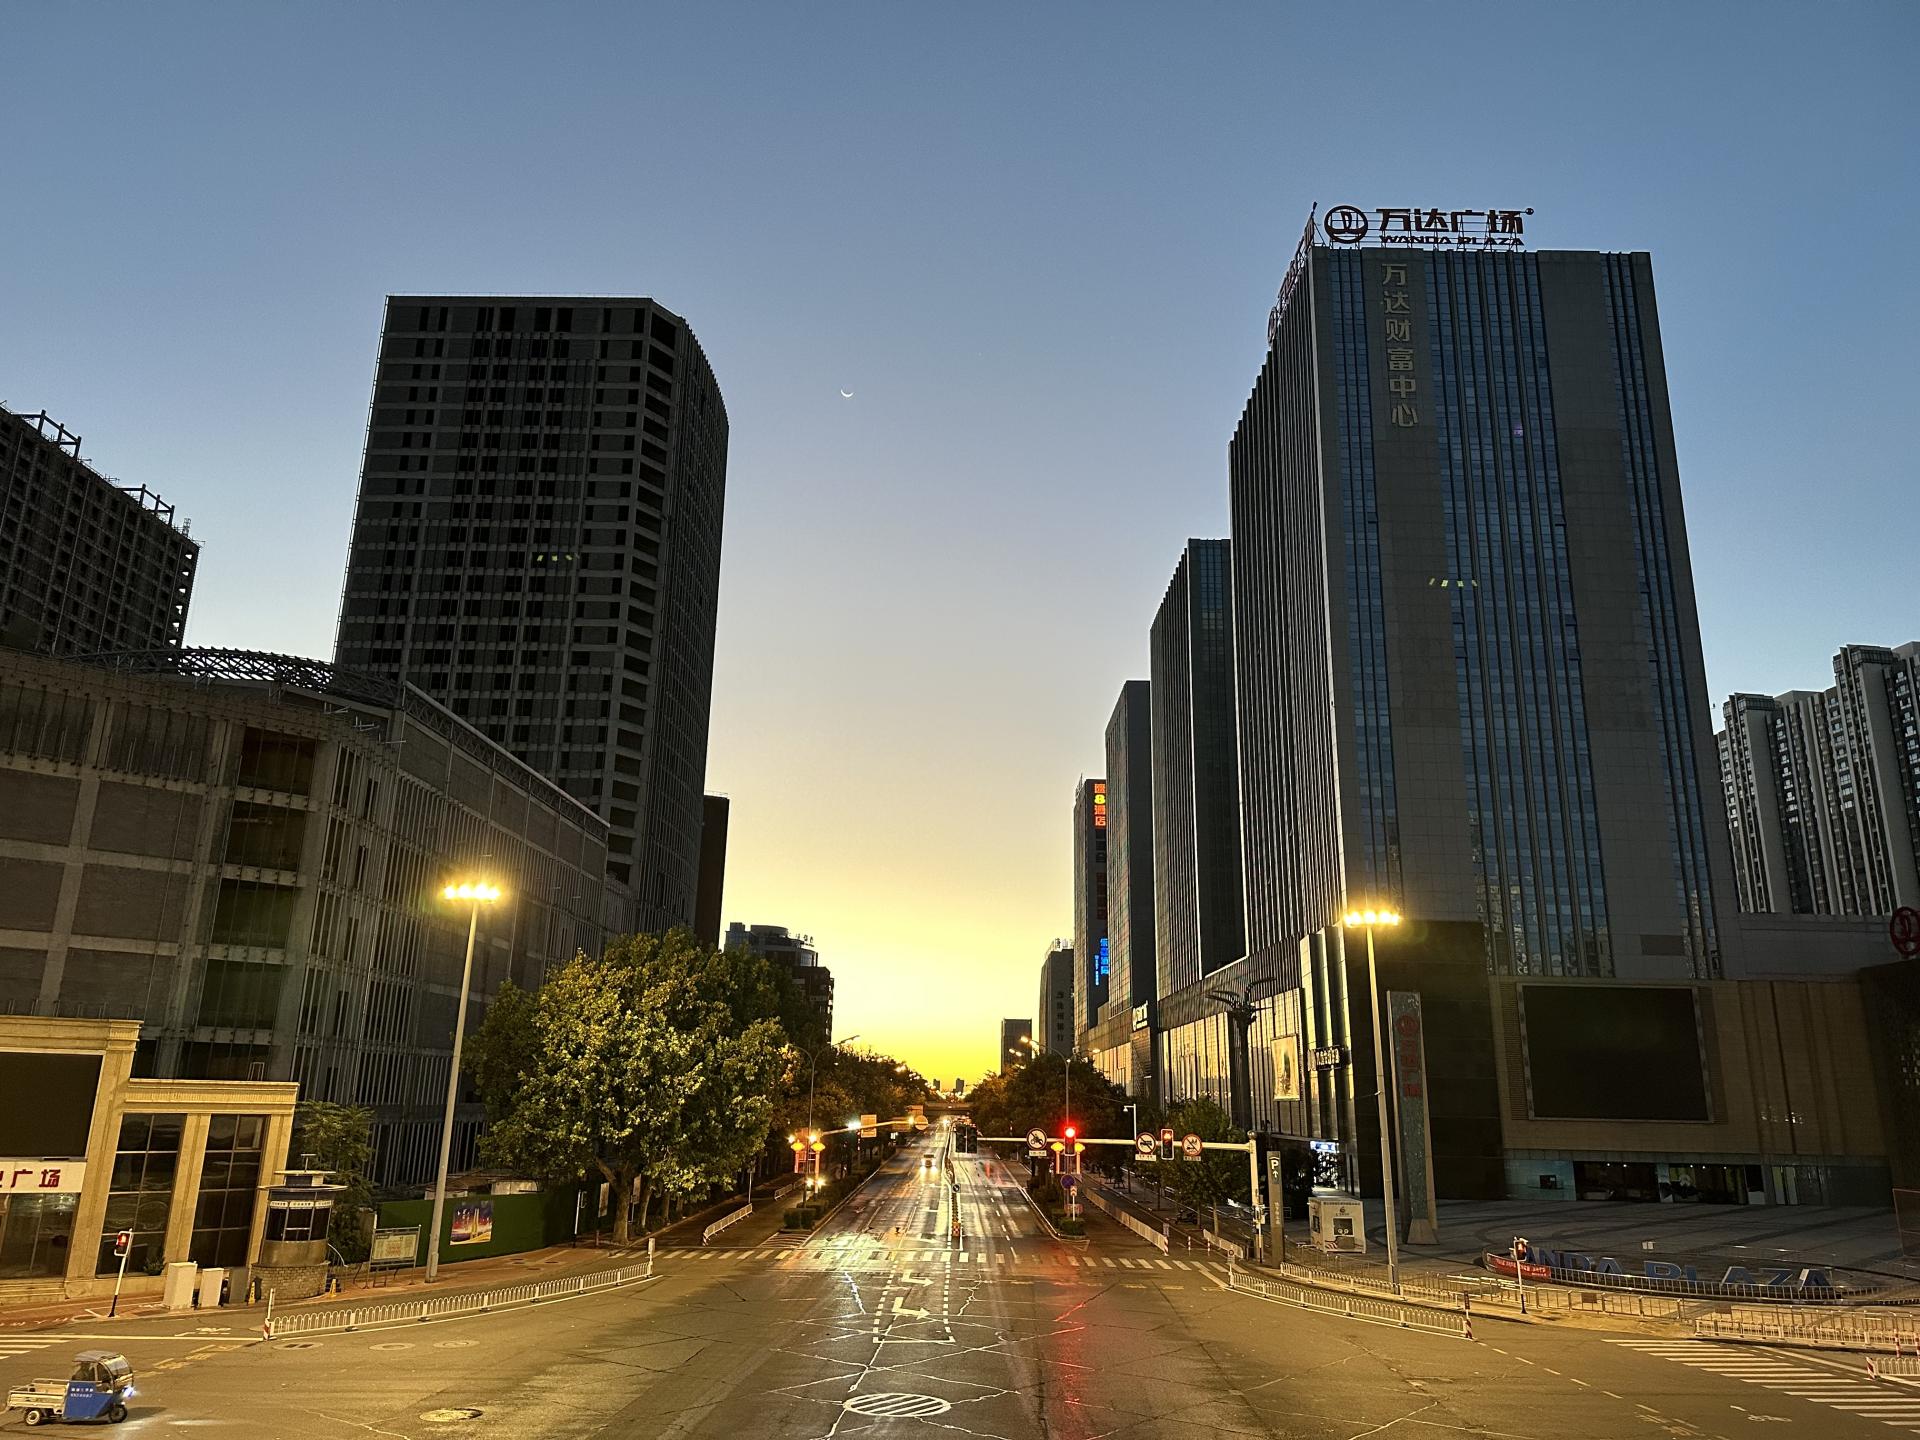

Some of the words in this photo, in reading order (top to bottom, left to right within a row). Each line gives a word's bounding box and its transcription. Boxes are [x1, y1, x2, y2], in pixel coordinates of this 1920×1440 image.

[1376, 208, 1524, 234] 万达广场
[1379, 235, 1451, 245] WANDA
[1457, 236, 1525, 246] PLAZA
[1381, 263, 1418, 428] 万达财富中心
[1271, 1160, 1279, 1170] P
[0, 1168, 61, 1189] 广场
[1519, 1246, 1623, 1275] ANDA
